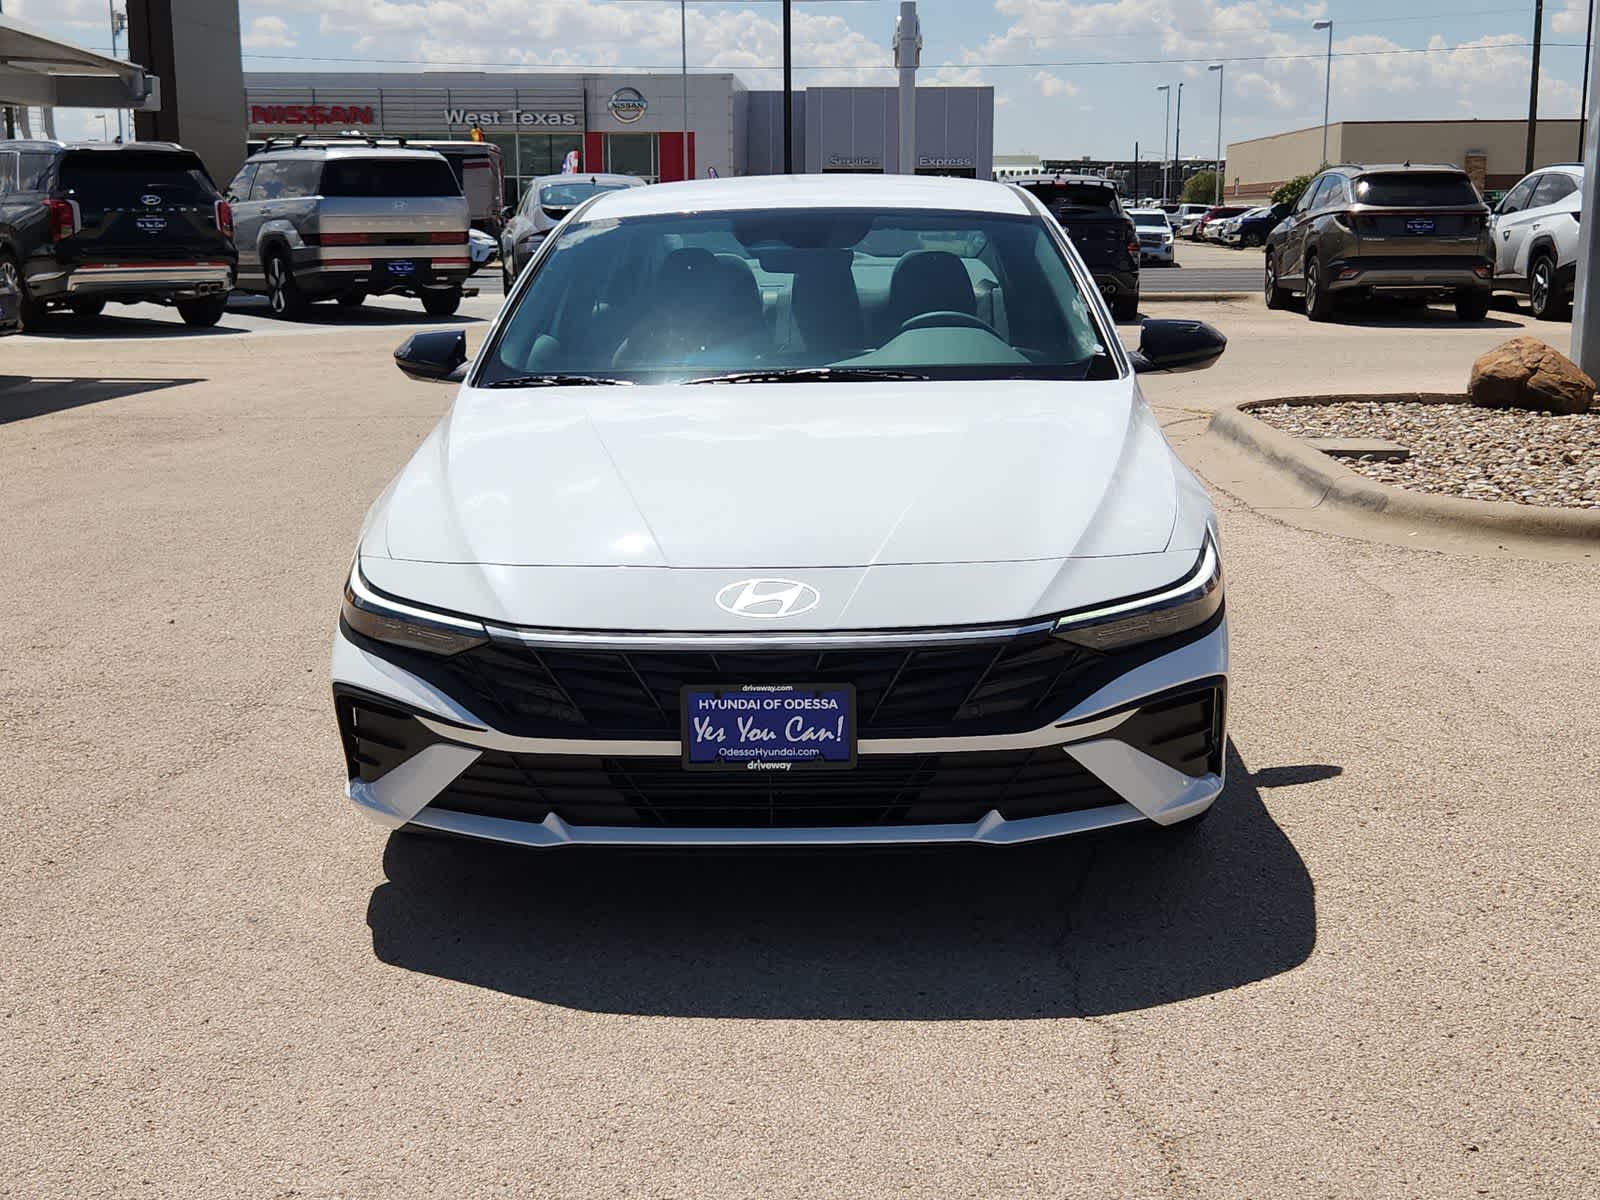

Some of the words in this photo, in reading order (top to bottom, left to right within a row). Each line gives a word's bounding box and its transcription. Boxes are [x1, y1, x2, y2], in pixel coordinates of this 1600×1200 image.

[612, 102, 644, 110] NISSAN
[251, 104, 373, 124] NISSAN
[444, 109, 500, 125] West
[509, 109, 576, 125] Texas
[919, 156, 971, 168] Express
[742, 684, 793, 692] driveway.com
[699, 699, 760, 710] HYUNDAI
[763, 699, 782, 710] OF
[784, 699, 838, 710] ODESSA
[693, 716, 727, 743] Yes
[737, 716, 777, 743] You
[785, 715, 845, 743] Can!
[718, 747, 820, 758] OdessaHyundai.com
[747, 760, 792, 771] driveway
